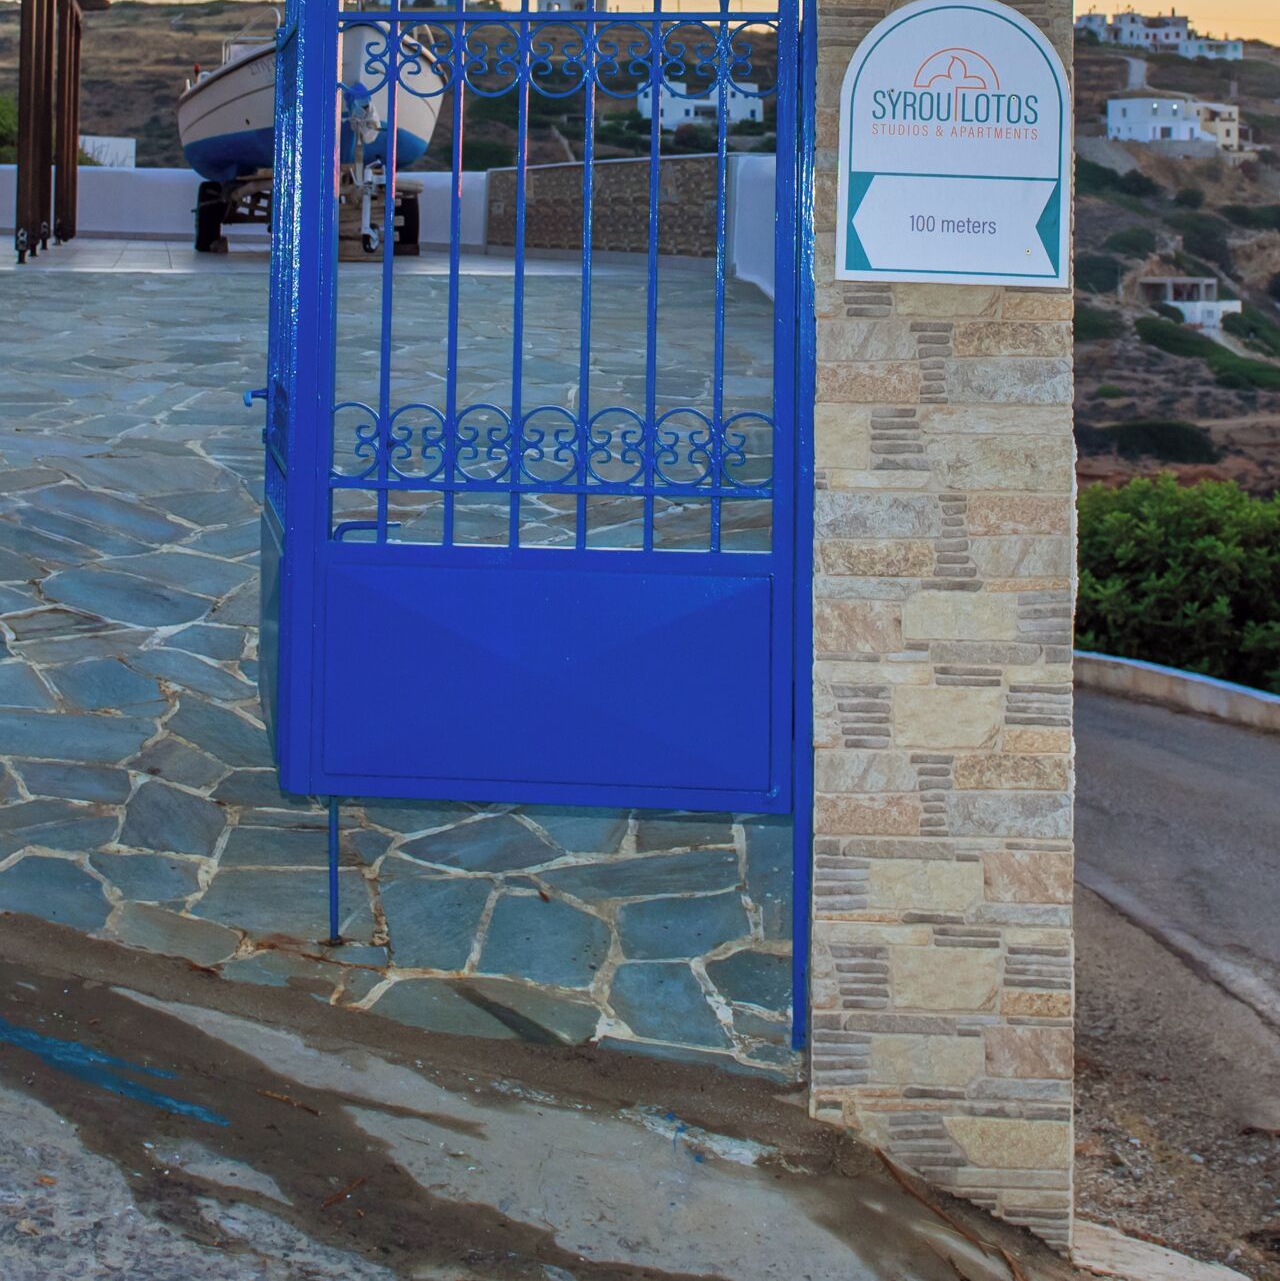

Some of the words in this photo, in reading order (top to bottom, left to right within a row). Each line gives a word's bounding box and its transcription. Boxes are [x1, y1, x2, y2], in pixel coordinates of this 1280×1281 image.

[871, 123, 929, 137] STUDIOS
[935, 125, 944, 137] &
[950, 125, 1038, 141] APARTMENTS
[909, 214, 936, 233] 100
[941, 217, 997, 235] meters
